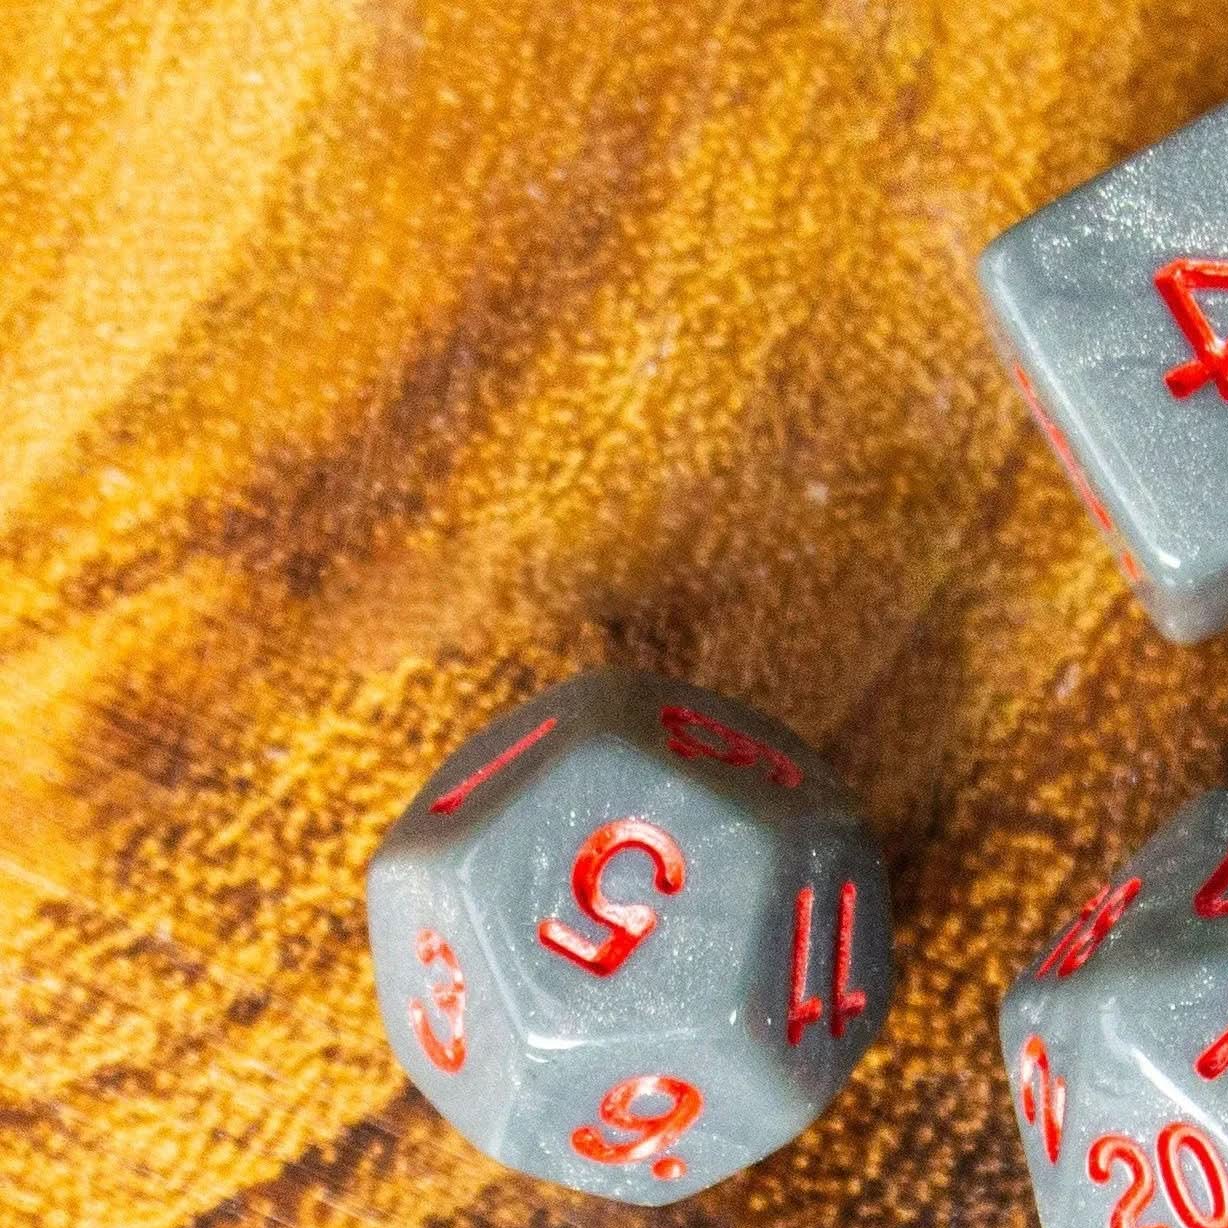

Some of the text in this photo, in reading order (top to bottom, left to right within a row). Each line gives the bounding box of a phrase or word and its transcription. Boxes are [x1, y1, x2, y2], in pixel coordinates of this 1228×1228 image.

[429, 717, 557, 818] 1
[538, 818, 687, 979] 5
[786, 879, 869, 1048] 11
[409, 928, 467, 1074] 3
